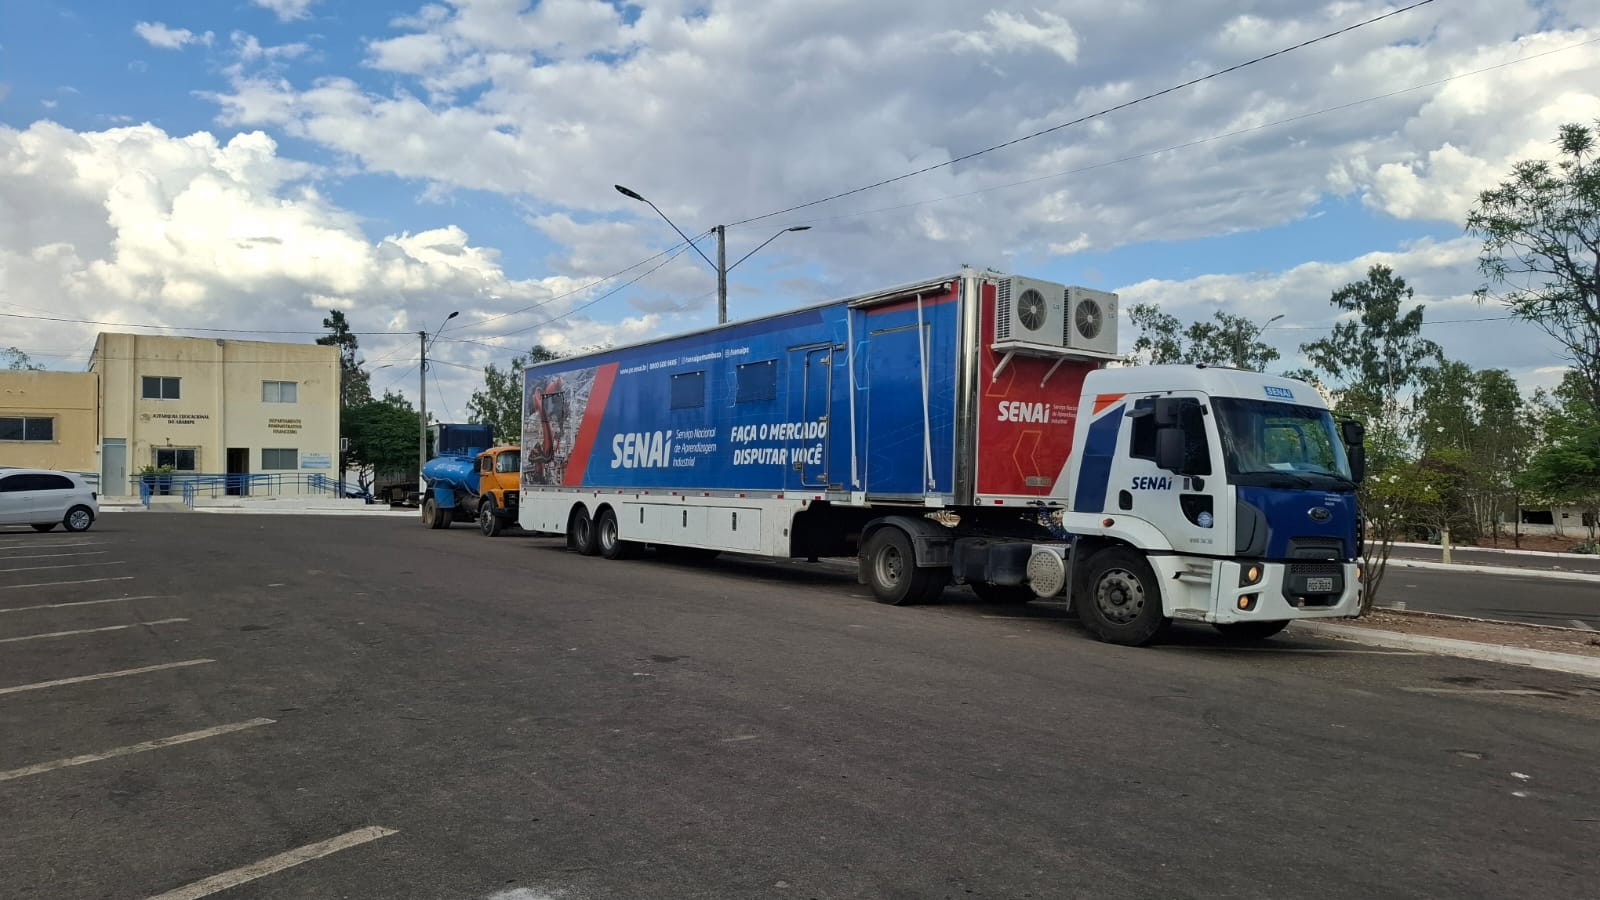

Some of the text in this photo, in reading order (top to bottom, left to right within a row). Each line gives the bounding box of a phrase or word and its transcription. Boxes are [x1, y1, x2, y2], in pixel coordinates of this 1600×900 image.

[676, 427, 717, 441] Serviço Nacional
[731, 421, 827, 445] FAÇA O MERCADO
[674, 443, 717, 455] de Aprendizagem
[733, 443, 822, 465] DISPUTAR VOCÊ
[673, 457, 696, 467] Industrial
